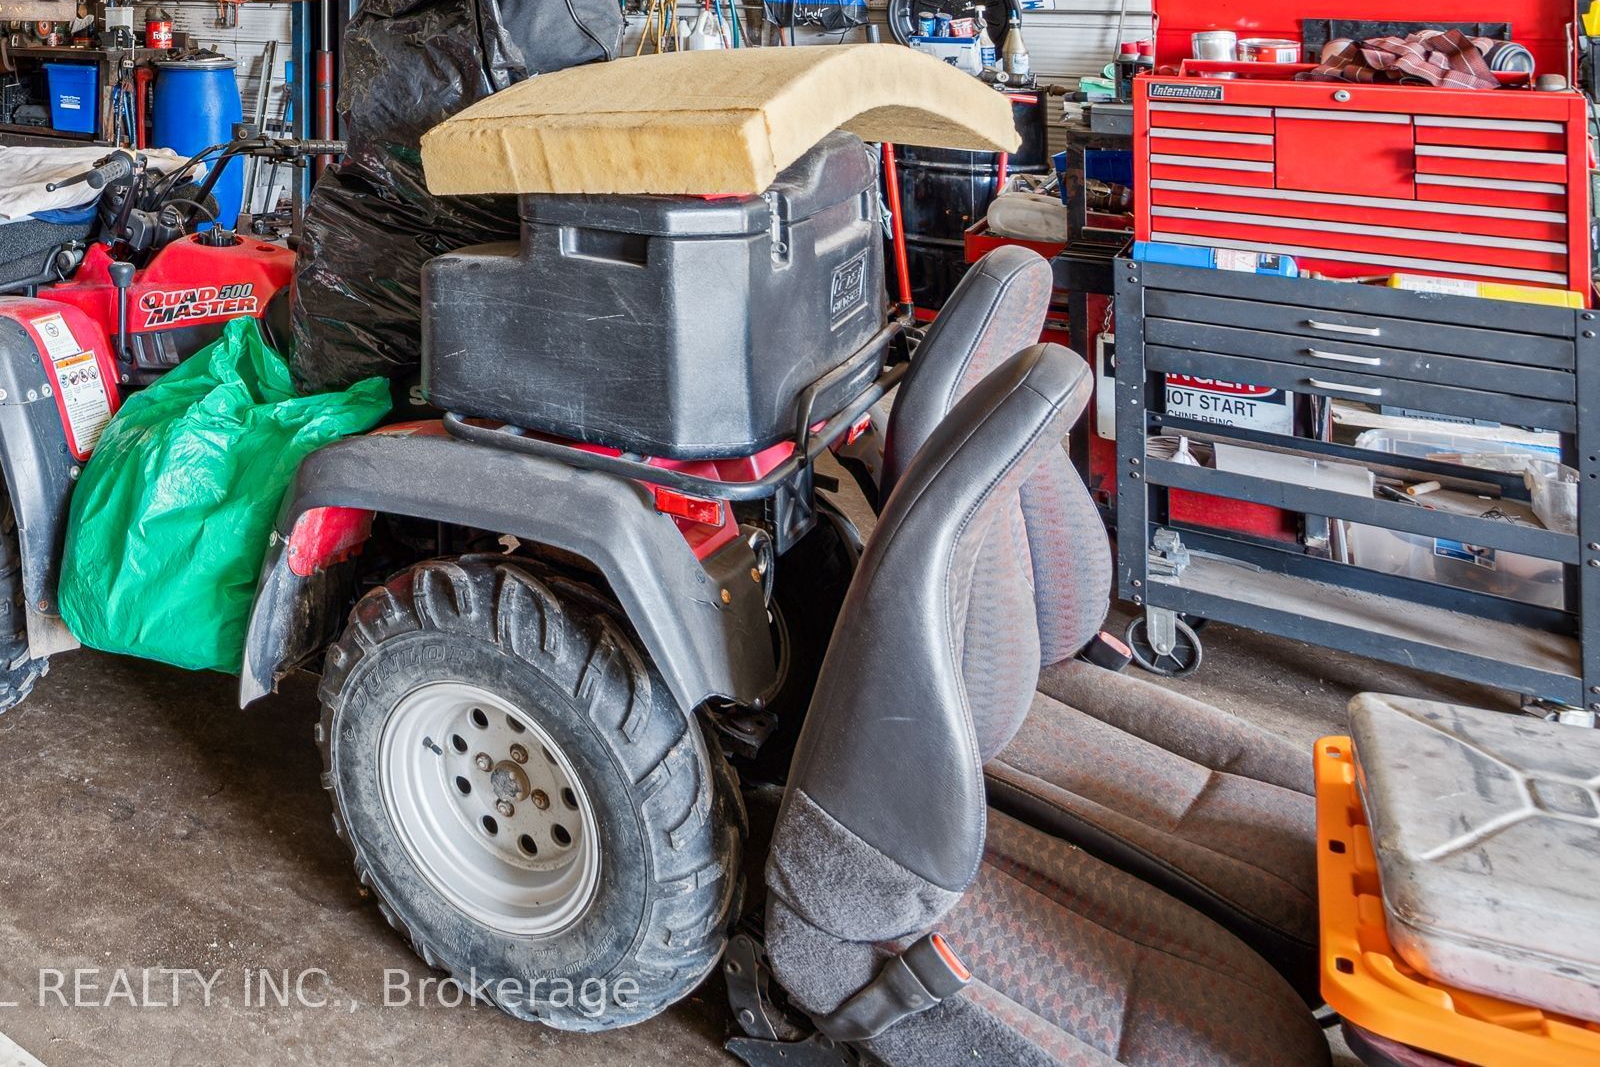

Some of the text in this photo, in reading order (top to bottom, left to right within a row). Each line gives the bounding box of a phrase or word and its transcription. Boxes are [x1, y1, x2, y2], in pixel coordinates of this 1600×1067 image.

[1153, 85, 1218, 98] International
[140, 283, 254, 312] QUAD 500
[144, 296, 257, 327] MASTER
[1167, 390, 1257, 417] OT START
[1167, 409, 1199, 422] CHINE
[350, 644, 476, 717] DUNLOP
